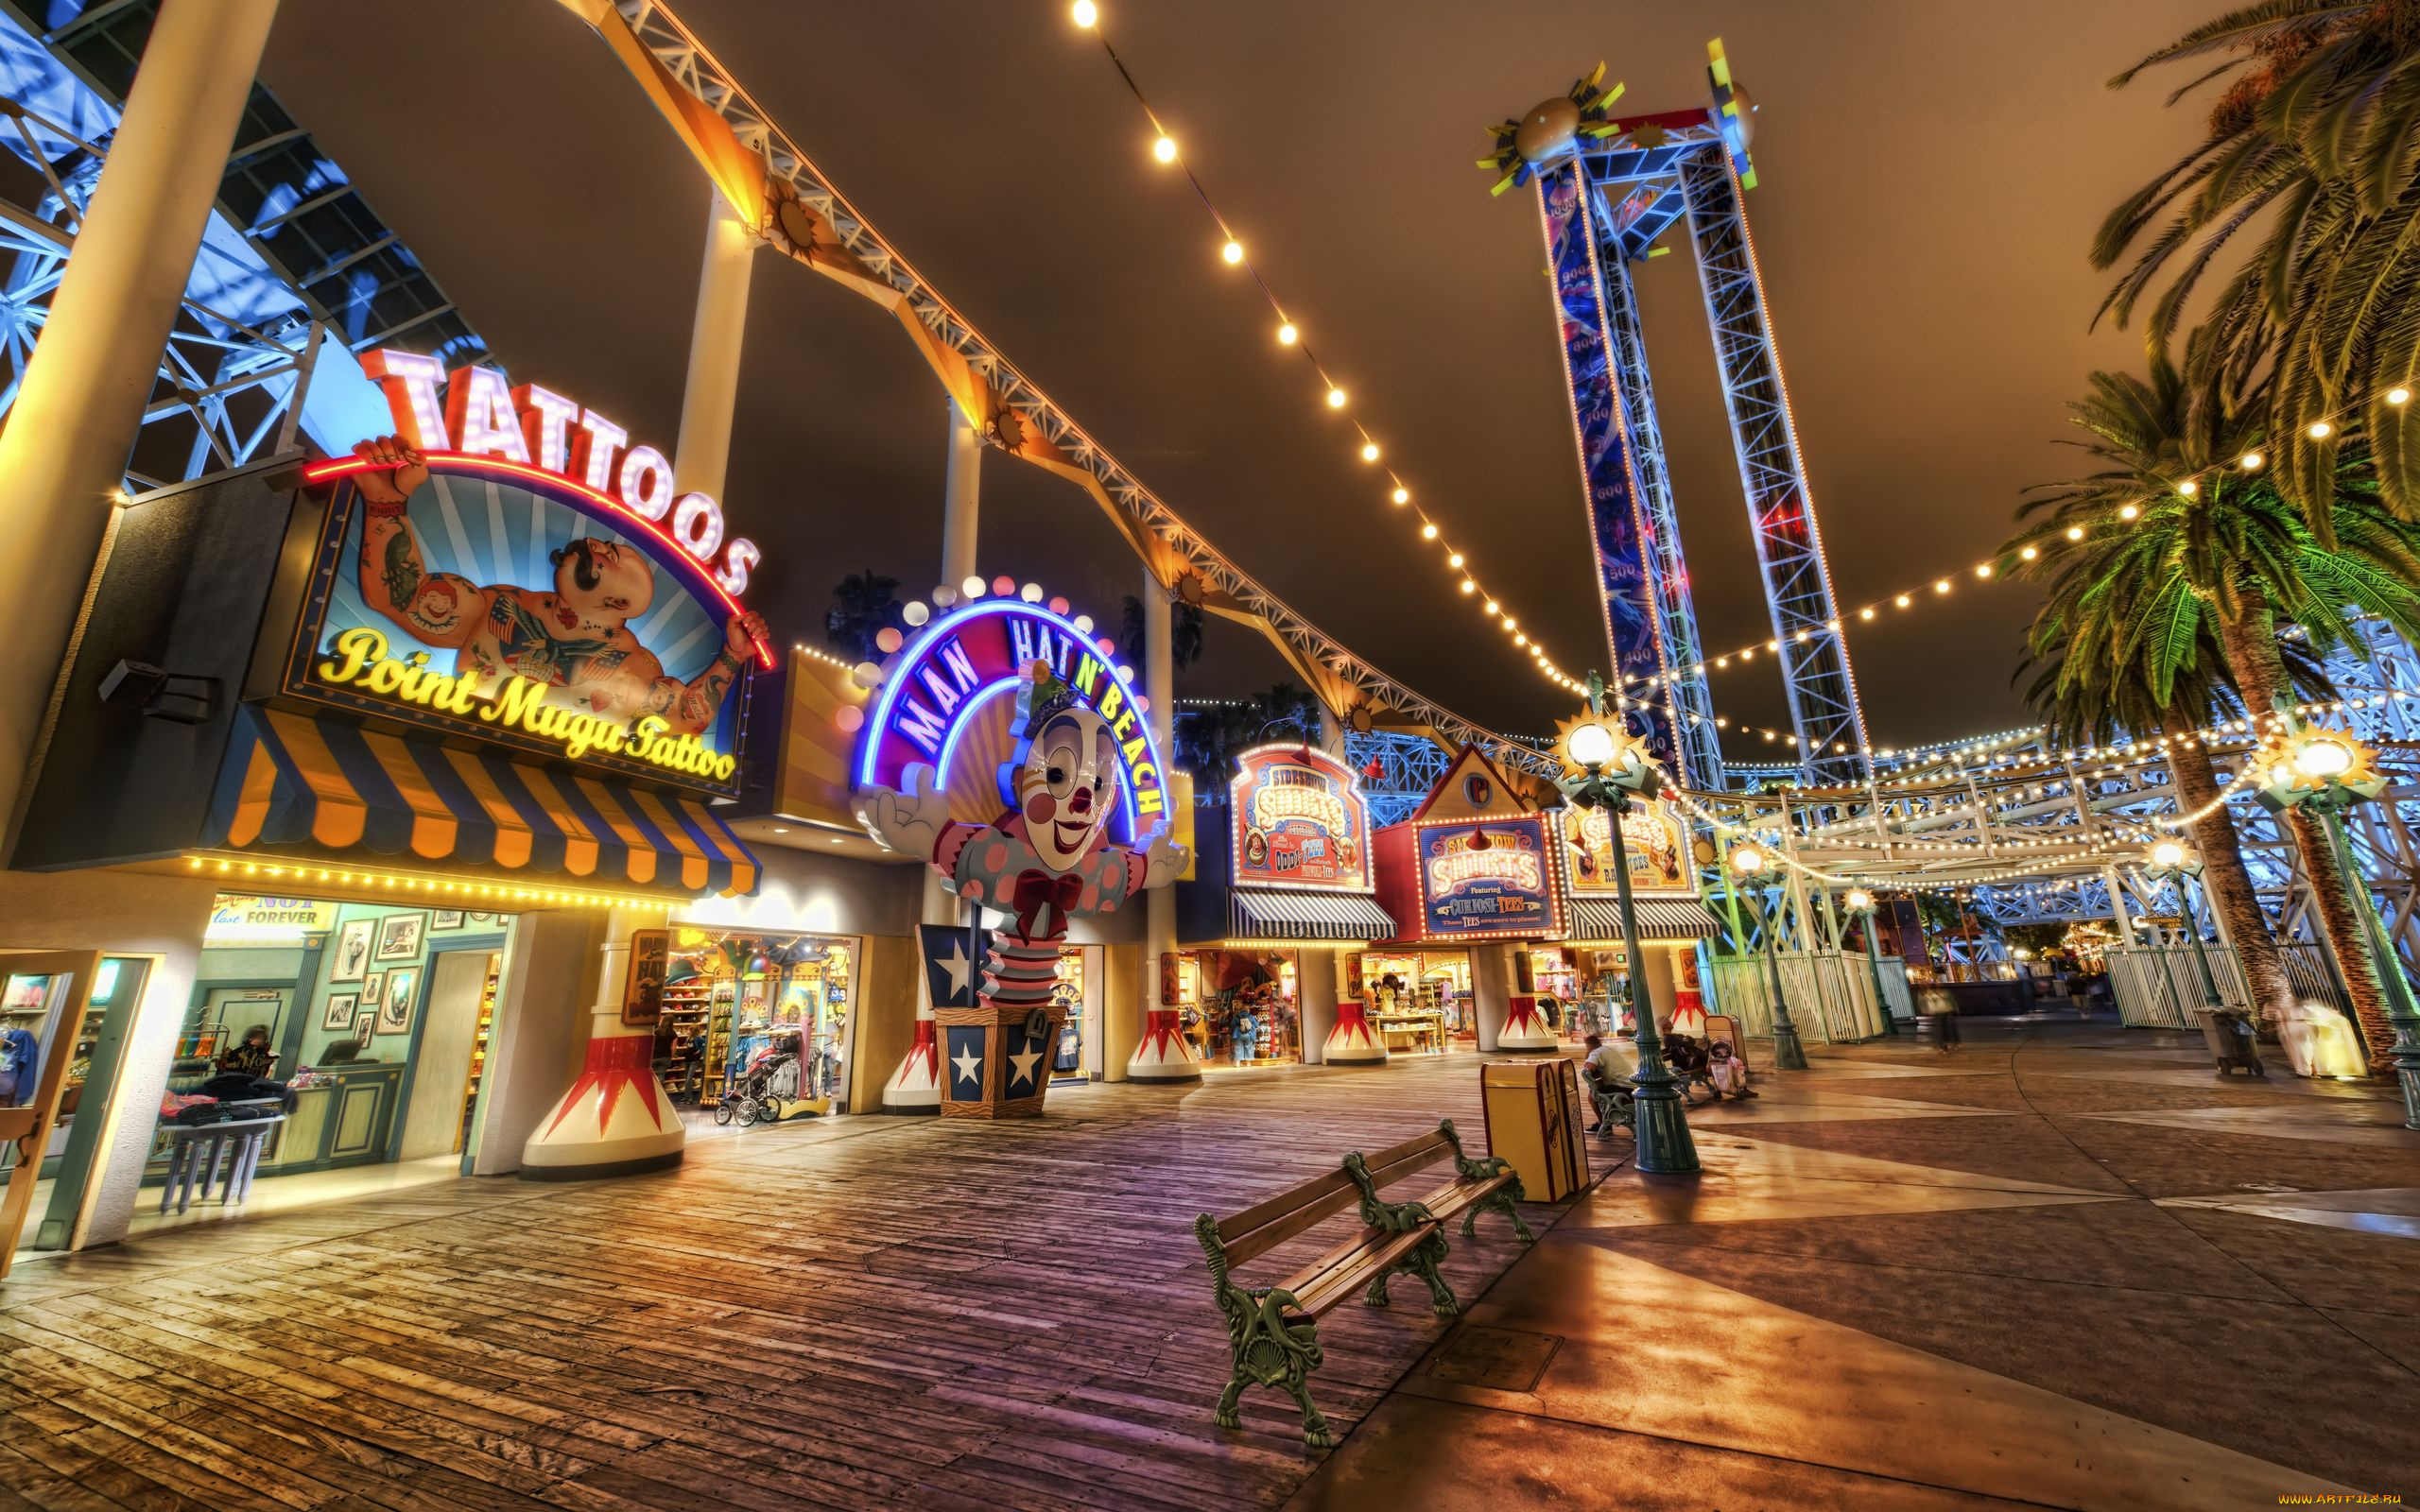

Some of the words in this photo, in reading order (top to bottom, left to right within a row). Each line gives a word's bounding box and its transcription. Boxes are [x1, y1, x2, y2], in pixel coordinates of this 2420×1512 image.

[1563, 265, 1585, 283] 900
[1573, 335, 1597, 352] 800
[1586, 407, 1609, 423] 700
[363, 348, 761, 596] TATTOOS
[1598, 483, 1622, 499] 600
[1610, 563, 1634, 580] 500
[1624, 647, 1651, 663] 400
[319, 627, 479, 714] Point
[479, 675, 626, 759] Mugu
[625, 714, 736, 781] Tattoo
[896, 636, 980, 755] MAN
[1009, 617, 1073, 677] HAT
[1099, 680, 1163, 815] BEACH
[1647, 736, 1666, 750] 00
[1272, 769, 1326, 794] SIDESHOW
[1432, 851, 1539, 894] SHIRTS
[1449, 896, 1524, 916] CURIOSI-TEES
[213, 908, 241, 923] last
[246, 911, 318, 923] FOREVER
[1461, 917, 1480, 928] TEES
